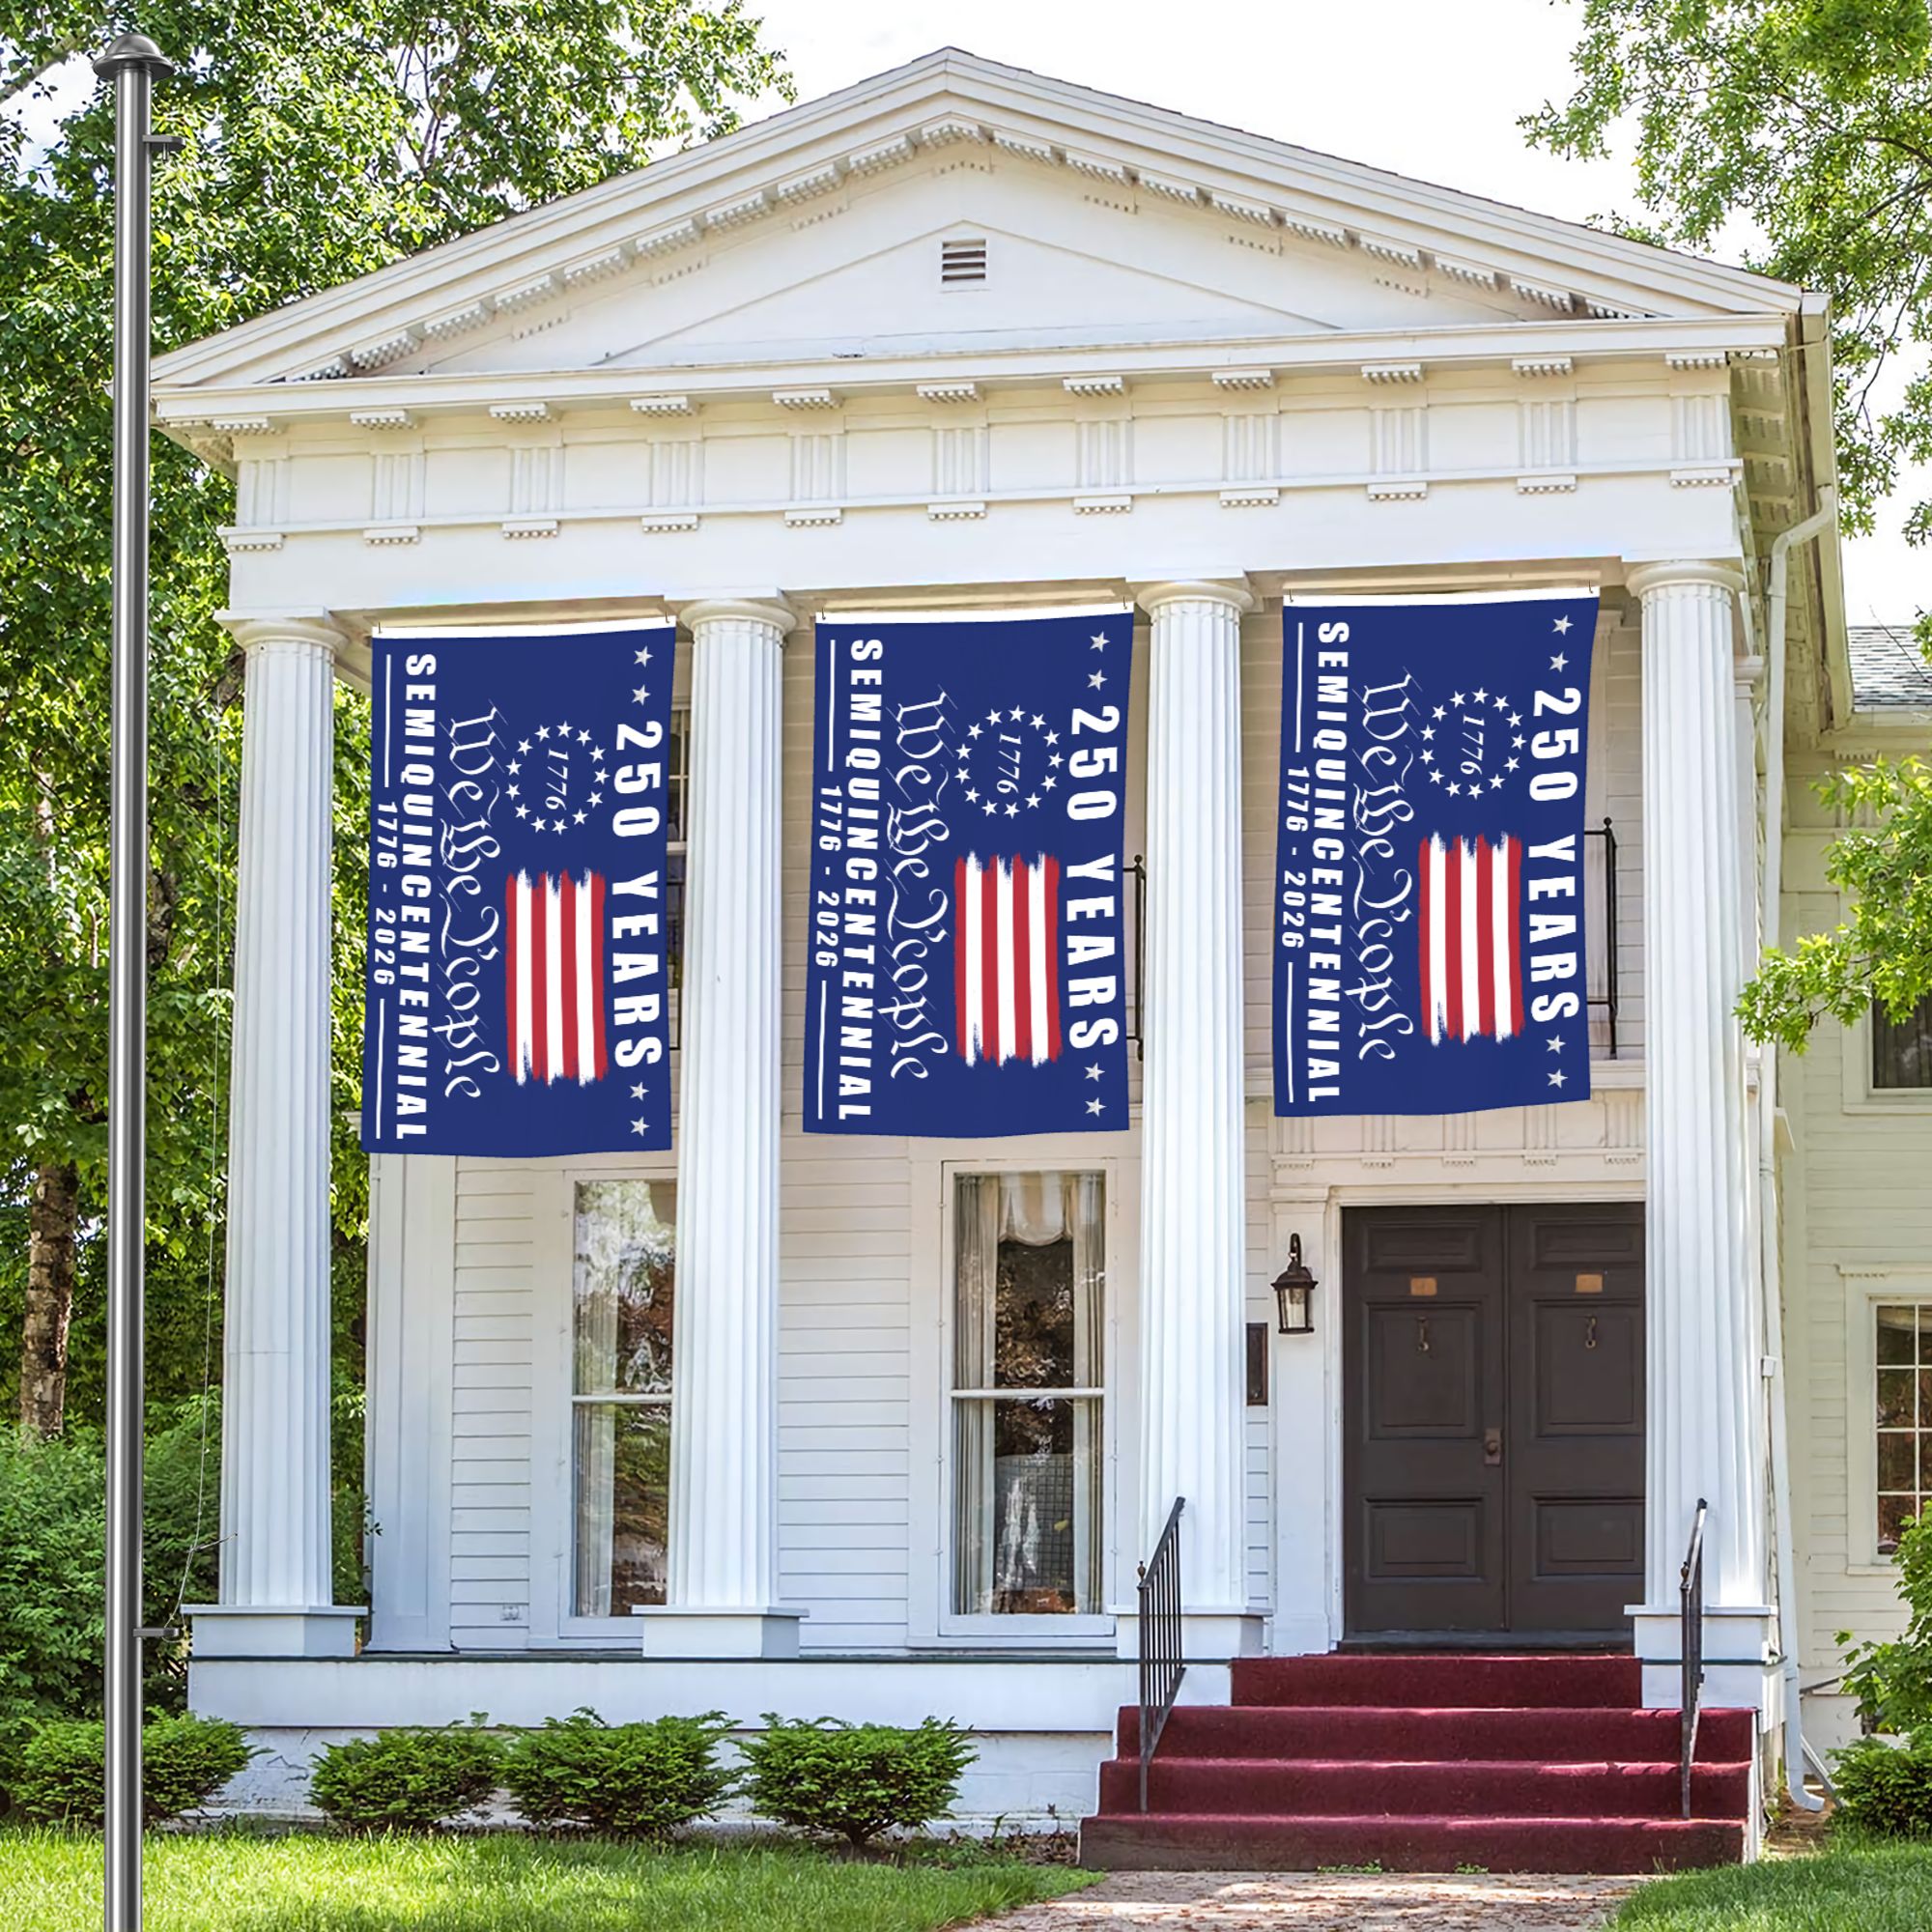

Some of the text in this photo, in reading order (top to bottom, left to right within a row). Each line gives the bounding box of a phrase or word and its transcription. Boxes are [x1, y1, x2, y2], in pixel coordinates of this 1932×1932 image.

[377, 802, 398, 867] 1776
[546, 749, 570, 810] 1776
[819, 786, 842, 851] 1776
[997, 734, 1021, 794] 1776
[1287, 767, 1309, 831] 1776
[1461, 716, 1484, 775] 1776
[374, 908, 397, 984] 2026
[397, 654, 436, 1139] SEMIQUINCENTENNIAL
[431, 698, 507, 1098] We the People
[612, 721, 663, 1067] 250 YEARS
[815, 891, 839, 966] 2026
[838, 639, 883, 1120] SEMIQUINCENTENNIAL
[873, 684, 957, 1079] We the People
[1066, 706, 1120, 1048] 250 YEARS
[1282, 870, 1307, 948] 2026
[1308, 622, 1350, 1102] SEMIQUINCENTENNIAL
[1343, 667, 1422, 1061] We the People
[1528, 688, 1581, 1022] 250 YEARS
